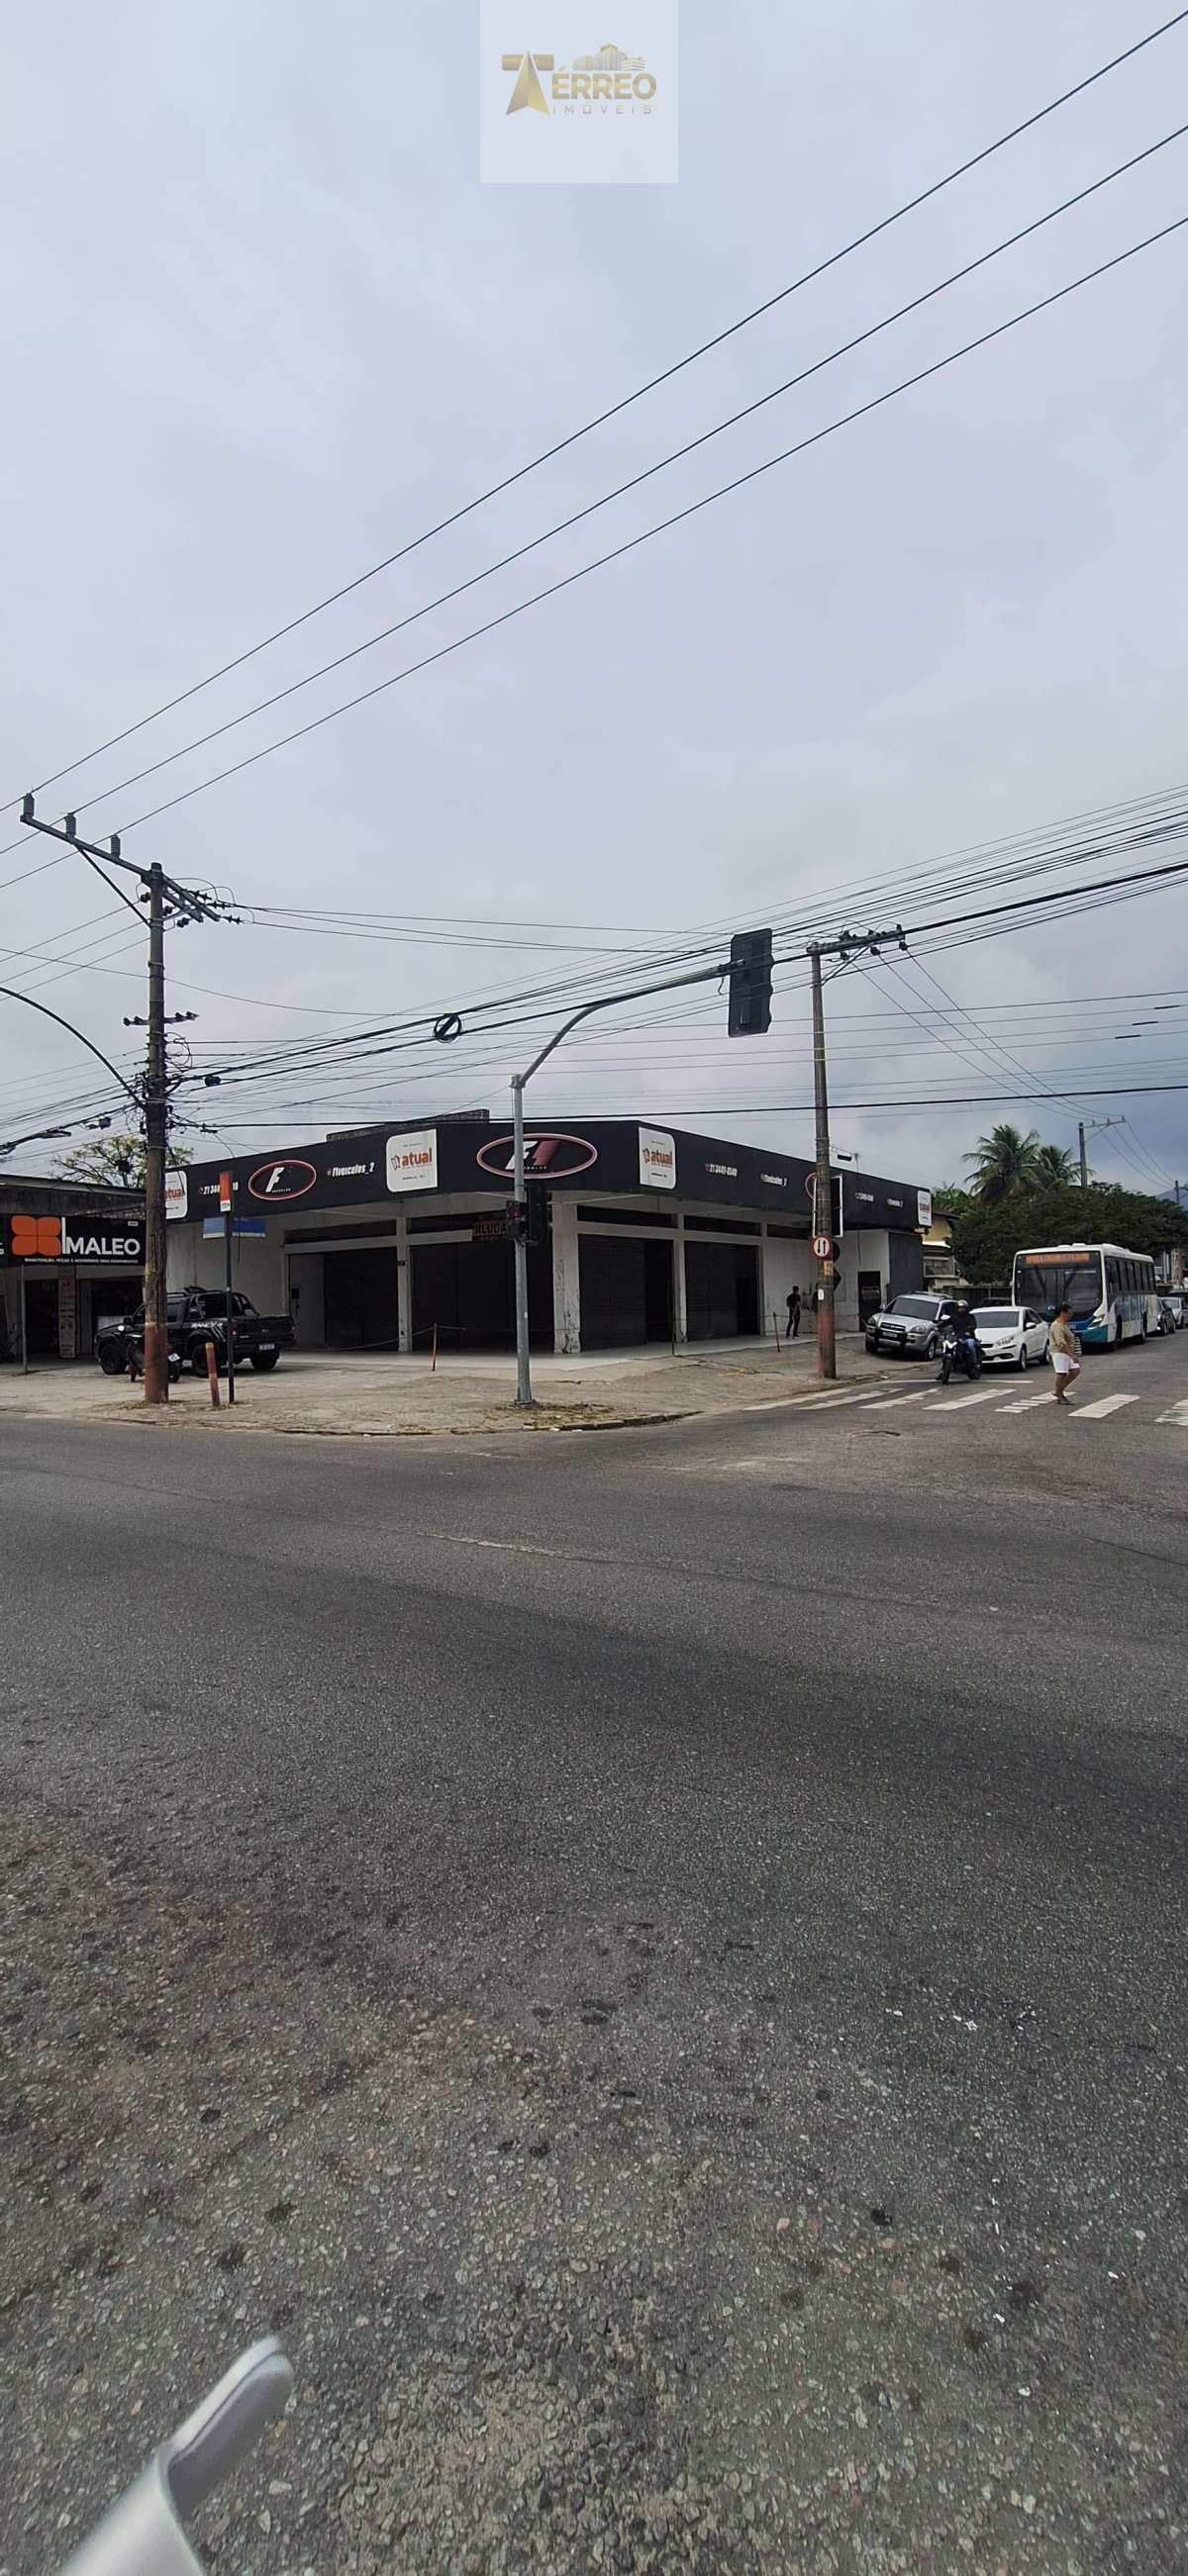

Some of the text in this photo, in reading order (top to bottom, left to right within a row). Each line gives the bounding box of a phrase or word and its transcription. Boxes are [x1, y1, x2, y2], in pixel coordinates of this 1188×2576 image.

[402, 1148, 433, 1167] atual
[650, 1149, 672, 1166] atual
[65, 1236, 141, 1255] MALEO
